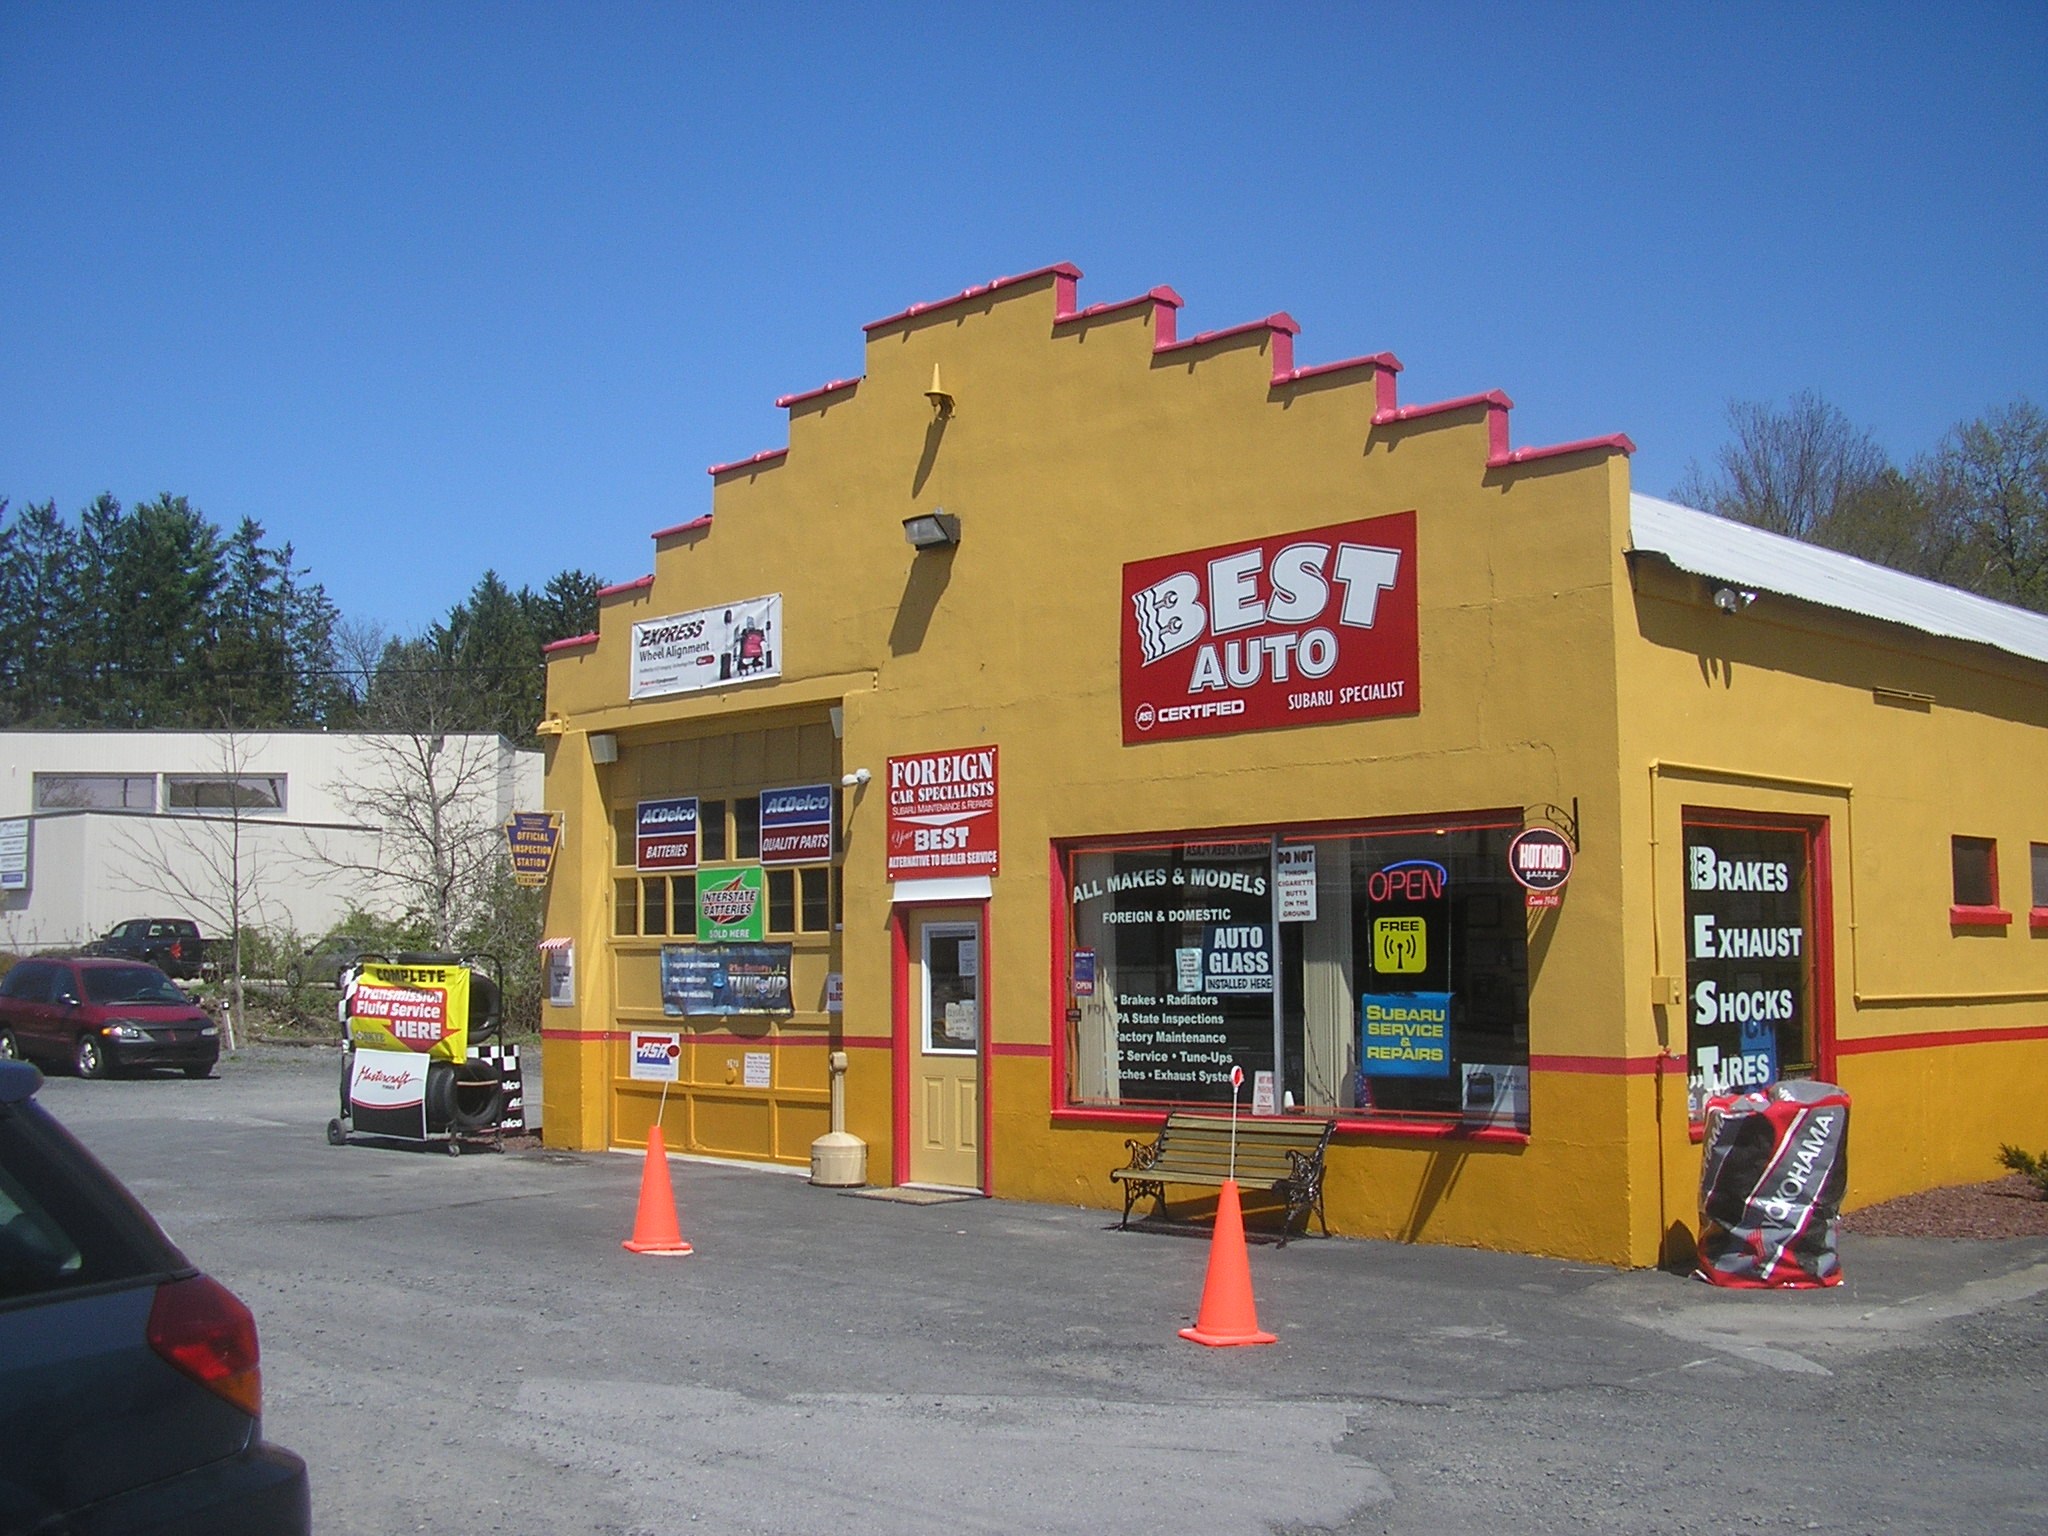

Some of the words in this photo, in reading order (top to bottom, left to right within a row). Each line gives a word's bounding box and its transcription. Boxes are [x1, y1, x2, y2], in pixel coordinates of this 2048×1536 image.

[1132, 542, 1402, 667] BEST
[639, 619, 705, 647] EXPRESS
[639, 645, 664, 662] Wheel
[666, 641, 711, 659] Alignment
[1188, 627, 1338, 694] AUTO
[1288, 690, 1333, 709] SUBARU
[1340, 681, 1404, 704] SPECIALIST
[1158, 699, 1245, 722] CERTIFIED
[891, 752, 993, 788] FOREIGN
[891, 790, 914, 804] CAR
[918, 781, 994, 802] SPECIALISTS
[765, 794, 829, 814] ACDelco
[892, 804, 917, 816] SUBARU
[918, 802, 960, 813] MAINTENANCE
[968, 799, 993, 809] REPAIRS
[641, 806, 695, 824] ACDelco
[516, 831, 549, 842] OFFICIAL
[763, 836, 799, 851] QUALITY
[799, 834, 829, 848] PARTS
[914, 827, 969, 851] BEST
[513, 844, 552, 855] INSPECTION
[646, 844, 688, 858] BATTERIES
[1278, 851, 1292, 864] DO
[1293, 850, 1313, 863] NOT
[1519, 844, 1541, 869] HOT
[1541, 844, 1564, 869] ROD
[516, 856, 546, 867] STATION
[888, 855, 930, 868] ALTERNATIVE
[931, 854, 941, 866] TO
[941, 852, 966, 865] DEALER
[967, 850, 997, 864] SERVICE
[1073, 880, 1103, 904] ALL
[1107, 868, 1167, 894] MAKES
[1172, 868, 1185, 885] &
[1191, 869, 1267, 896] MODELS
[1278, 879, 1314, 887] CIGARETTE
[1369, 869, 1442, 902] OPEN
[703, 891, 756, 902] INTERSTATE
[1284, 899, 1295, 907] ON
[704, 904, 752, 915] BATTERIES
[1103, 910, 1153, 924] FOREIGN
[1156, 910, 1165, 922] &
[1168, 908, 1231, 922] DOMESTIC
[1282, 909, 1310, 917] GROUND
[709, 930, 728, 938] SOLD
[730, 929, 749, 938] HERE
[1380, 920, 1420, 932] FREE
[1214, 926, 1263, 949] AUTO
[1209, 951, 1269, 974] GLASS
[376, 968, 446, 982] COMPLETE
[1207, 979, 1248, 989] INSTALLED
[1250, 978, 1273, 989] HERE
[1076, 981, 1092, 990] OPEN
[359, 986, 444, 1003] Transmission
[1120, 995, 1156, 1006] Brakes
[1167, 994, 1218, 1006] Radiators
[356, 1001, 389, 1015] Fluid
[390, 1003, 440, 1018] Service
[1366, 1005, 1445, 1022] SUBARU
[1132, 1013, 1160, 1024] State
[1162, 1013, 1224, 1026] Inspections
[395, 1020, 442, 1039] HERE
[1156, 1031, 1227, 1043] Maintenance
[1367, 1023, 1444, 1037] SERVICE
[1401, 1037, 1411, 1048] &
[1127, 1051, 1168, 1062] Service
[1180, 1051, 1233, 1066] Tune-Ups
[1367, 1047, 1444, 1061] REPAIRS
[355, 1065, 412, 1089] Mastercraft
[1154, 1069, 1196, 1081] Exhaust
[1761, 1113, 1834, 1229] YOKOHAMA
